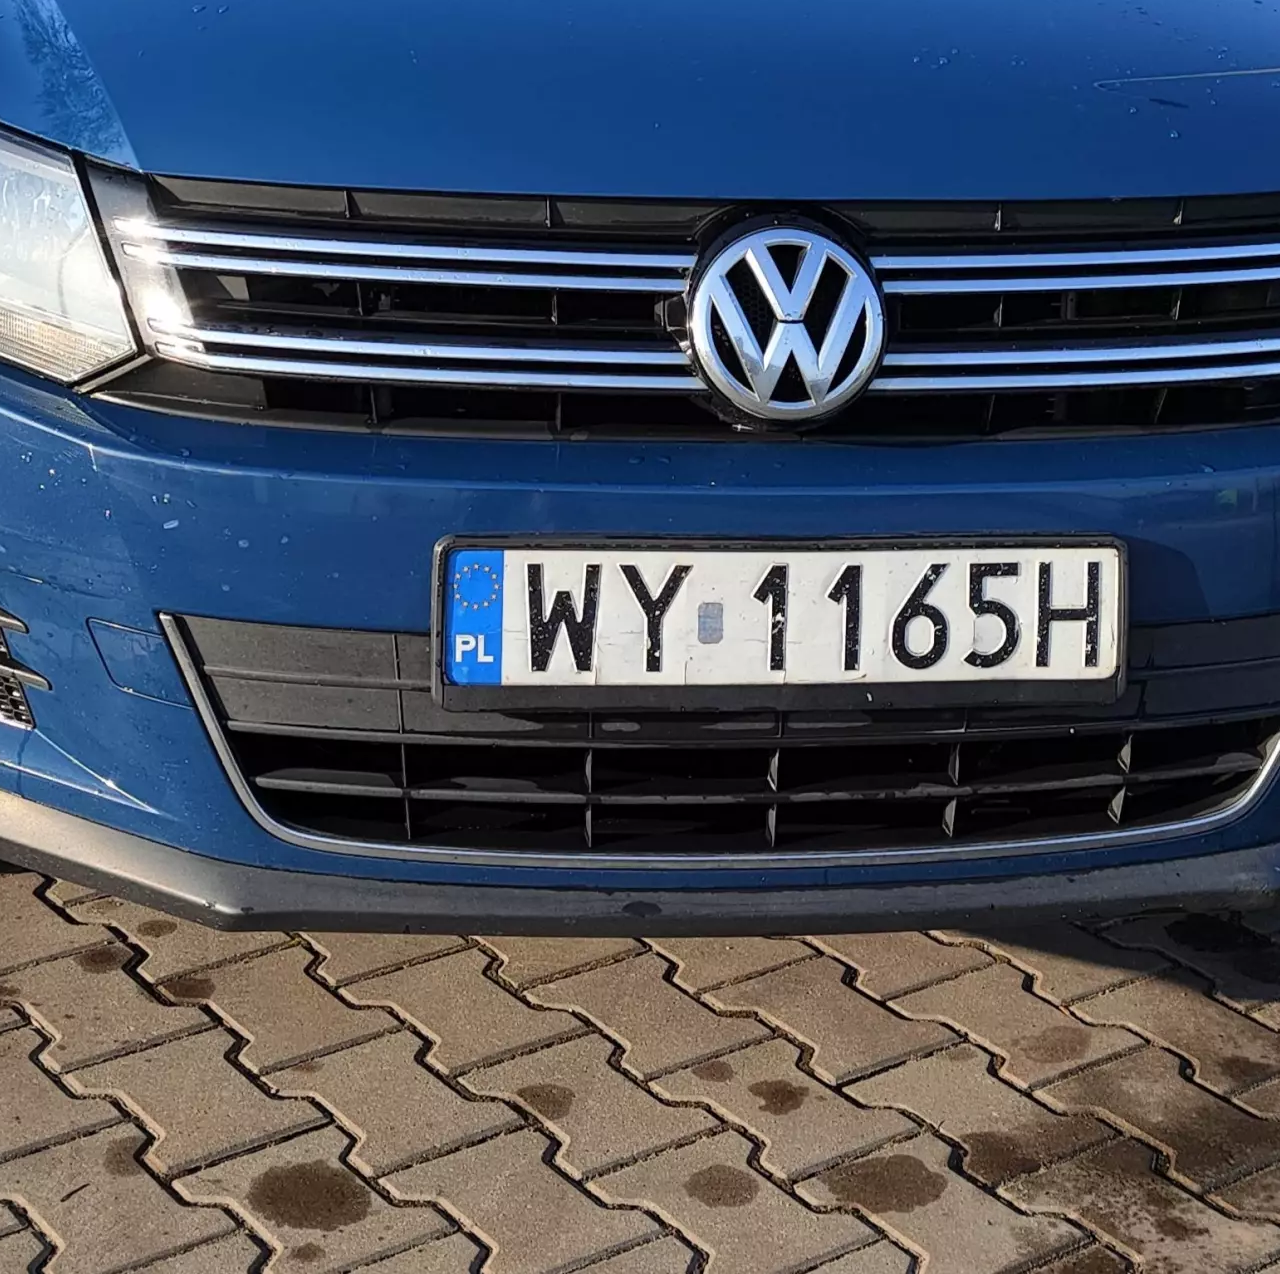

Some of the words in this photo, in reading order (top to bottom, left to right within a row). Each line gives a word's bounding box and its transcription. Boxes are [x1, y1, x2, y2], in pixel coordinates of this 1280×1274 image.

[696, 230, 880, 416] VW
[455, 635, 494, 663] PL
[527, 563, 693, 672] WY
[753, 562, 1100, 671] 1165H
